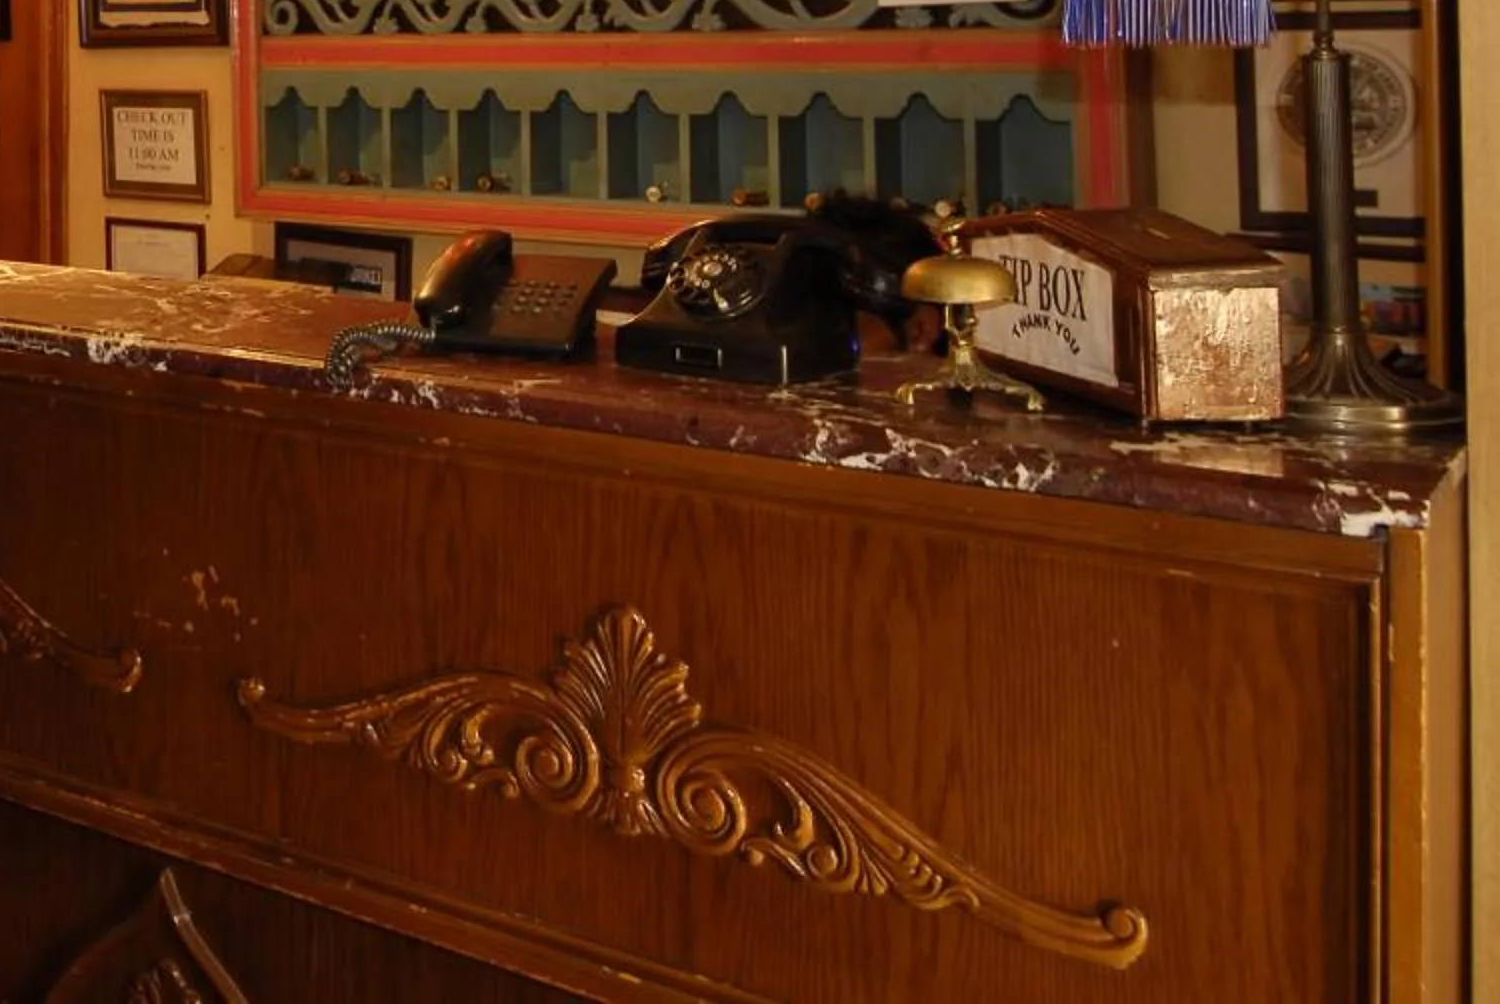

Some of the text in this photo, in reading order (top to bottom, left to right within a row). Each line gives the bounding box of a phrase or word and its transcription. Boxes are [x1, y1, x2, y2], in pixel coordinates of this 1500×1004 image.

[1039, 262, 1087, 321] BOX
[1011, 313, 1081, 355] THANK YOU
